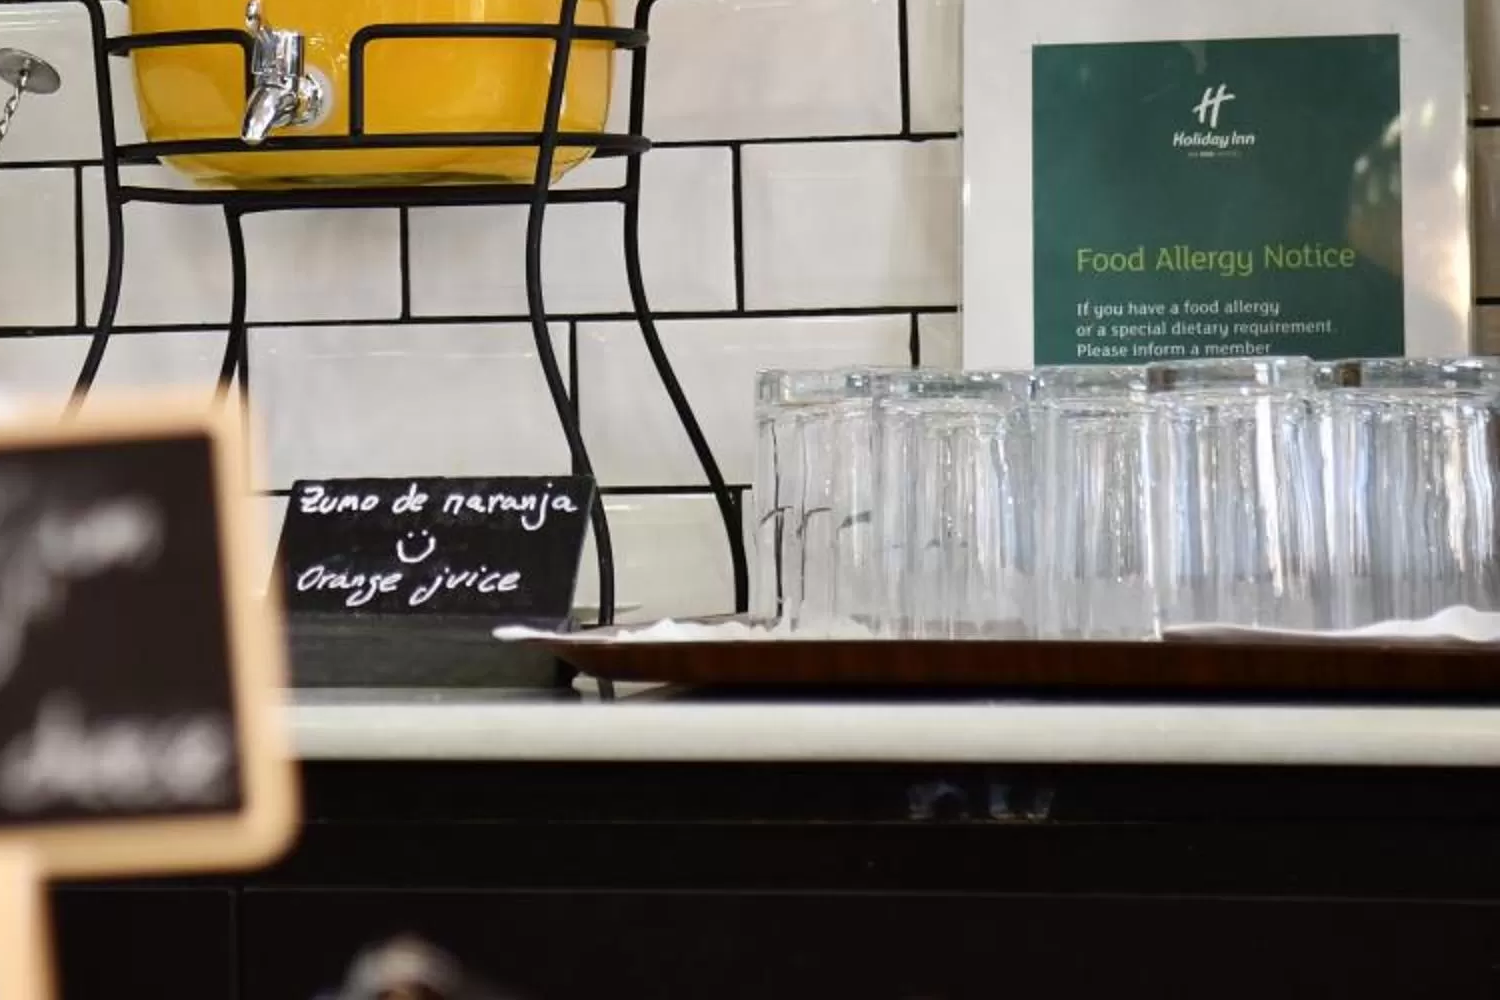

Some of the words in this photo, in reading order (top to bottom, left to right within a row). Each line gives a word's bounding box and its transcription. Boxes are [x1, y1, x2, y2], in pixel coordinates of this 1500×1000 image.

[1172, 131, 1229, 149] Holiday
[1231, 130, 1256, 146] Inn
[1076, 246, 1146, 272] Food
[1155, 245, 1253, 277] Allergy
[1264, 242, 1357, 269] Notice
[1076, 299, 1091, 316] If
[1094, 303, 1123, 319] you
[1127, 301, 1165, 315] have
[1170, 304, 1180, 315] a
[1184, 300, 1220, 315] food
[1224, 299, 1281, 316] allergy
[1076, 324, 1093, 338] or
[1111, 320, 1167, 341] special
[1170, 320, 1229, 339] dietary
[1077, 343, 1127, 358] Please
[1190, 344, 1200, 356] a
[1204, 341, 1271, 356] member
[300, 485, 379, 514] Zumo
[391, 482, 429, 514] de
[442, 482, 578, 531] naranja
[297, 565, 403, 607] Orange
